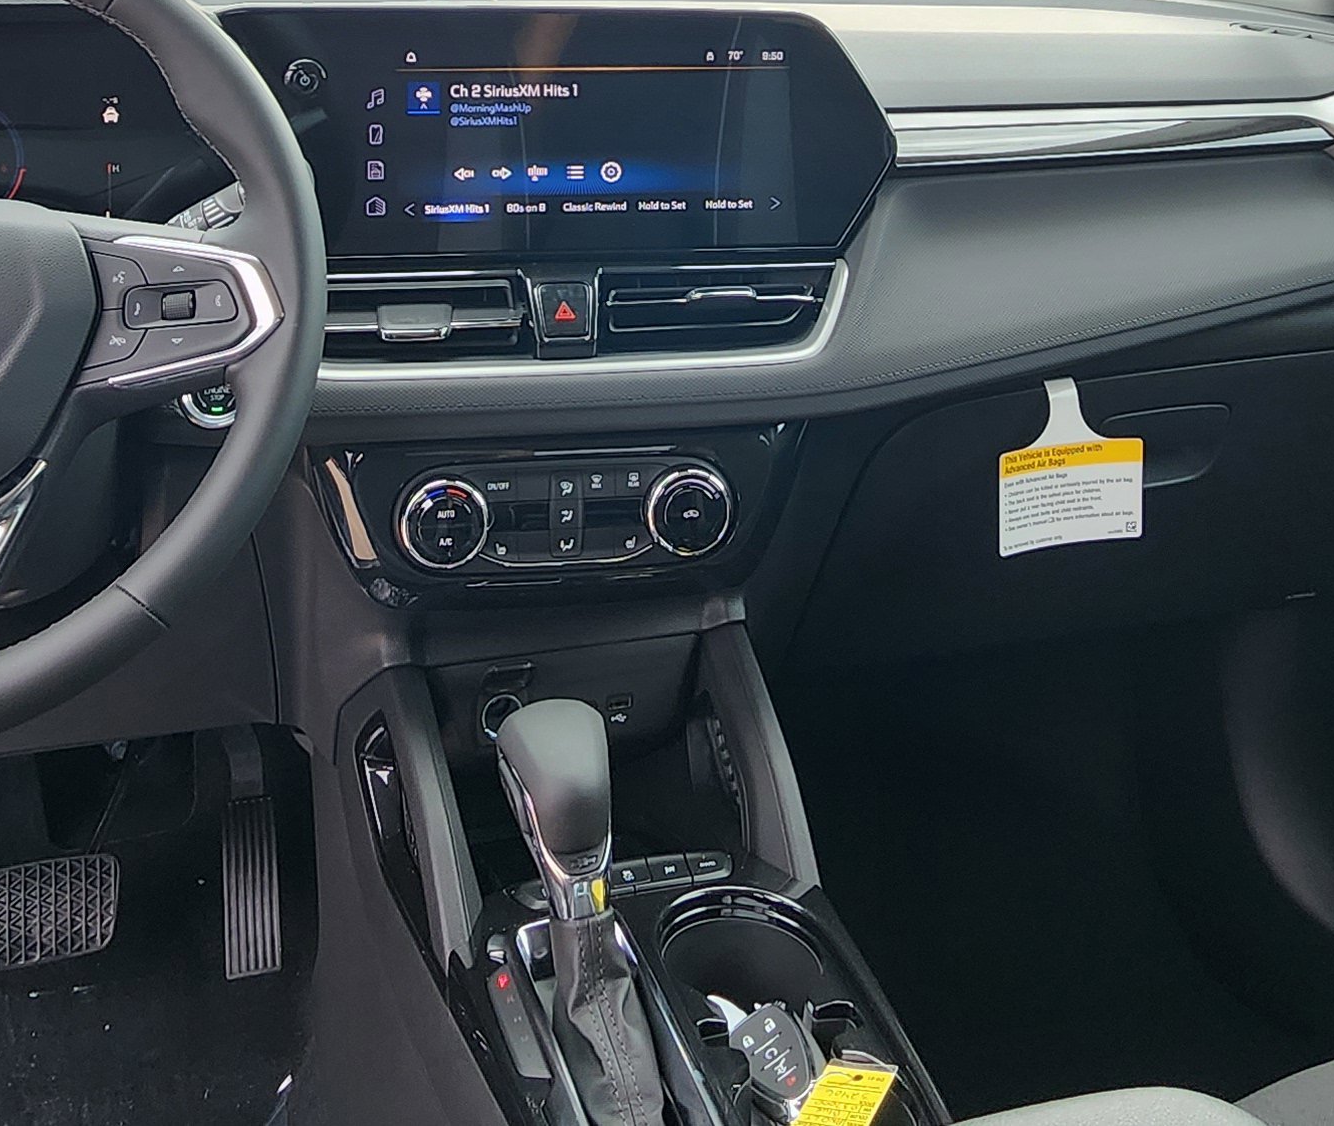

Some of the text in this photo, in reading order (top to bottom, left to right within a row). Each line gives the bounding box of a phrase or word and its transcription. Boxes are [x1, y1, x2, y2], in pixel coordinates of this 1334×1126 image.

[450, 83, 579, 98] Ch 2 SiriusXM Hits 1
[450, 102, 532, 114] @MorningMashUp
[450, 116, 517, 127] @SiriusXMHits1
[112, 164, 120, 173] H
[425, 204, 490, 214] SiriusXM Hits 1
[526, 204, 538, 213] on
[563, 201, 627, 213] Classic Rewind
[638, 200, 686, 211] Hold to Set
[705, 199, 753, 209] Hold to Set
[210, 394, 225, 402] STOP
[1005, 443, 1103, 465] This Vehicle is Equipped with
[1005, 458, 1066, 475] Advanced Air Bags
[487, 481, 510, 491] ON/OFF
[437, 509, 456, 519] AUTO
[439, 537, 453, 547] A/C
